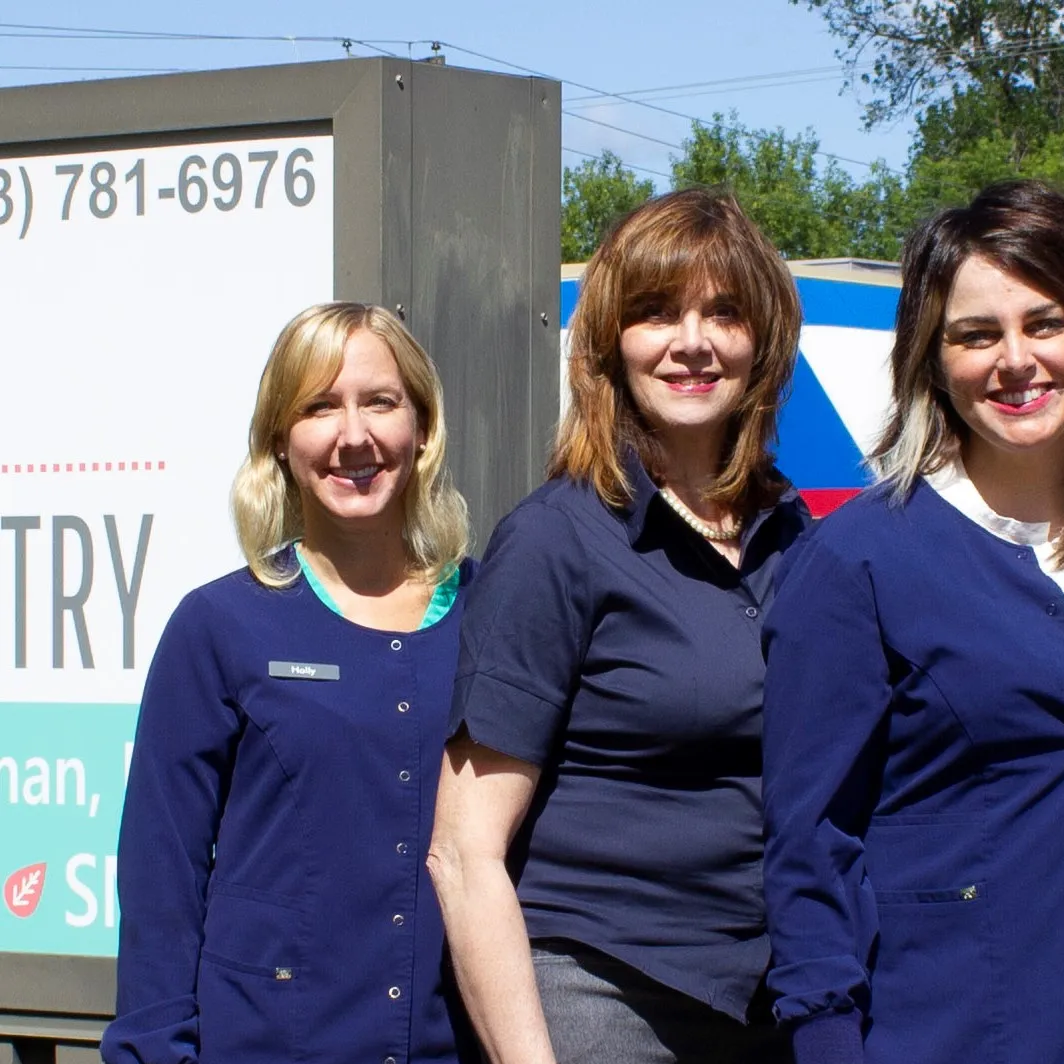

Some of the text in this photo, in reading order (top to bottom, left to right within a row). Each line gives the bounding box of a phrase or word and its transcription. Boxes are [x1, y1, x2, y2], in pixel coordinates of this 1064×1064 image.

[55, 147, 316, 221] 781-6976
[1, 514, 154, 670] TRY
[290, 665, 317, 677] Holly
